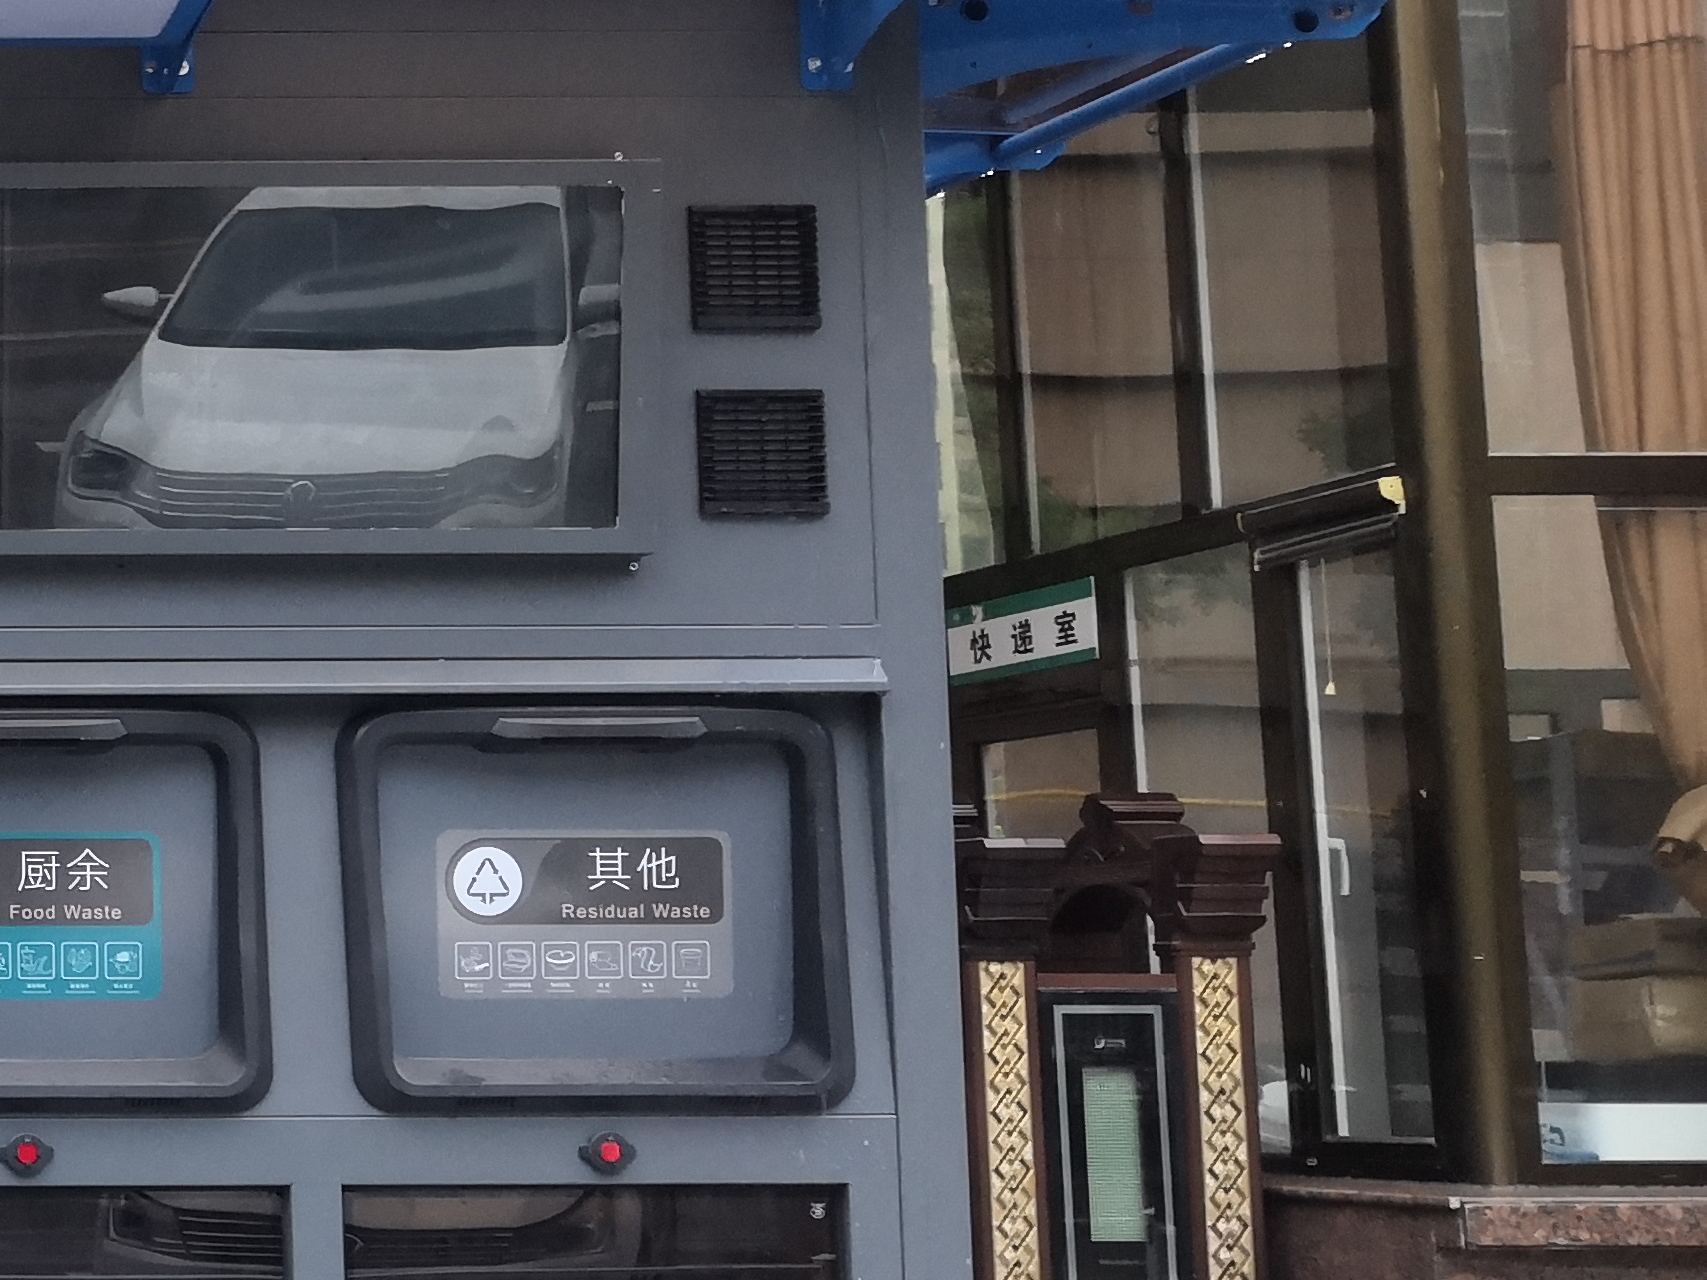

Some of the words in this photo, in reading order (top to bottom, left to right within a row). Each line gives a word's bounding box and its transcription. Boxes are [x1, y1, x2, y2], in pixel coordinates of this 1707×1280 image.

[970, 611, 1079, 664] 快递室
[17, 848, 110, 891] 厨余
[587, 846, 680, 891] 其他
[9, 904, 57, 920] Food
[63, 904, 122, 920] Waste
[561, 903, 644, 919] Residual
[652, 903, 710, 919] Waste
